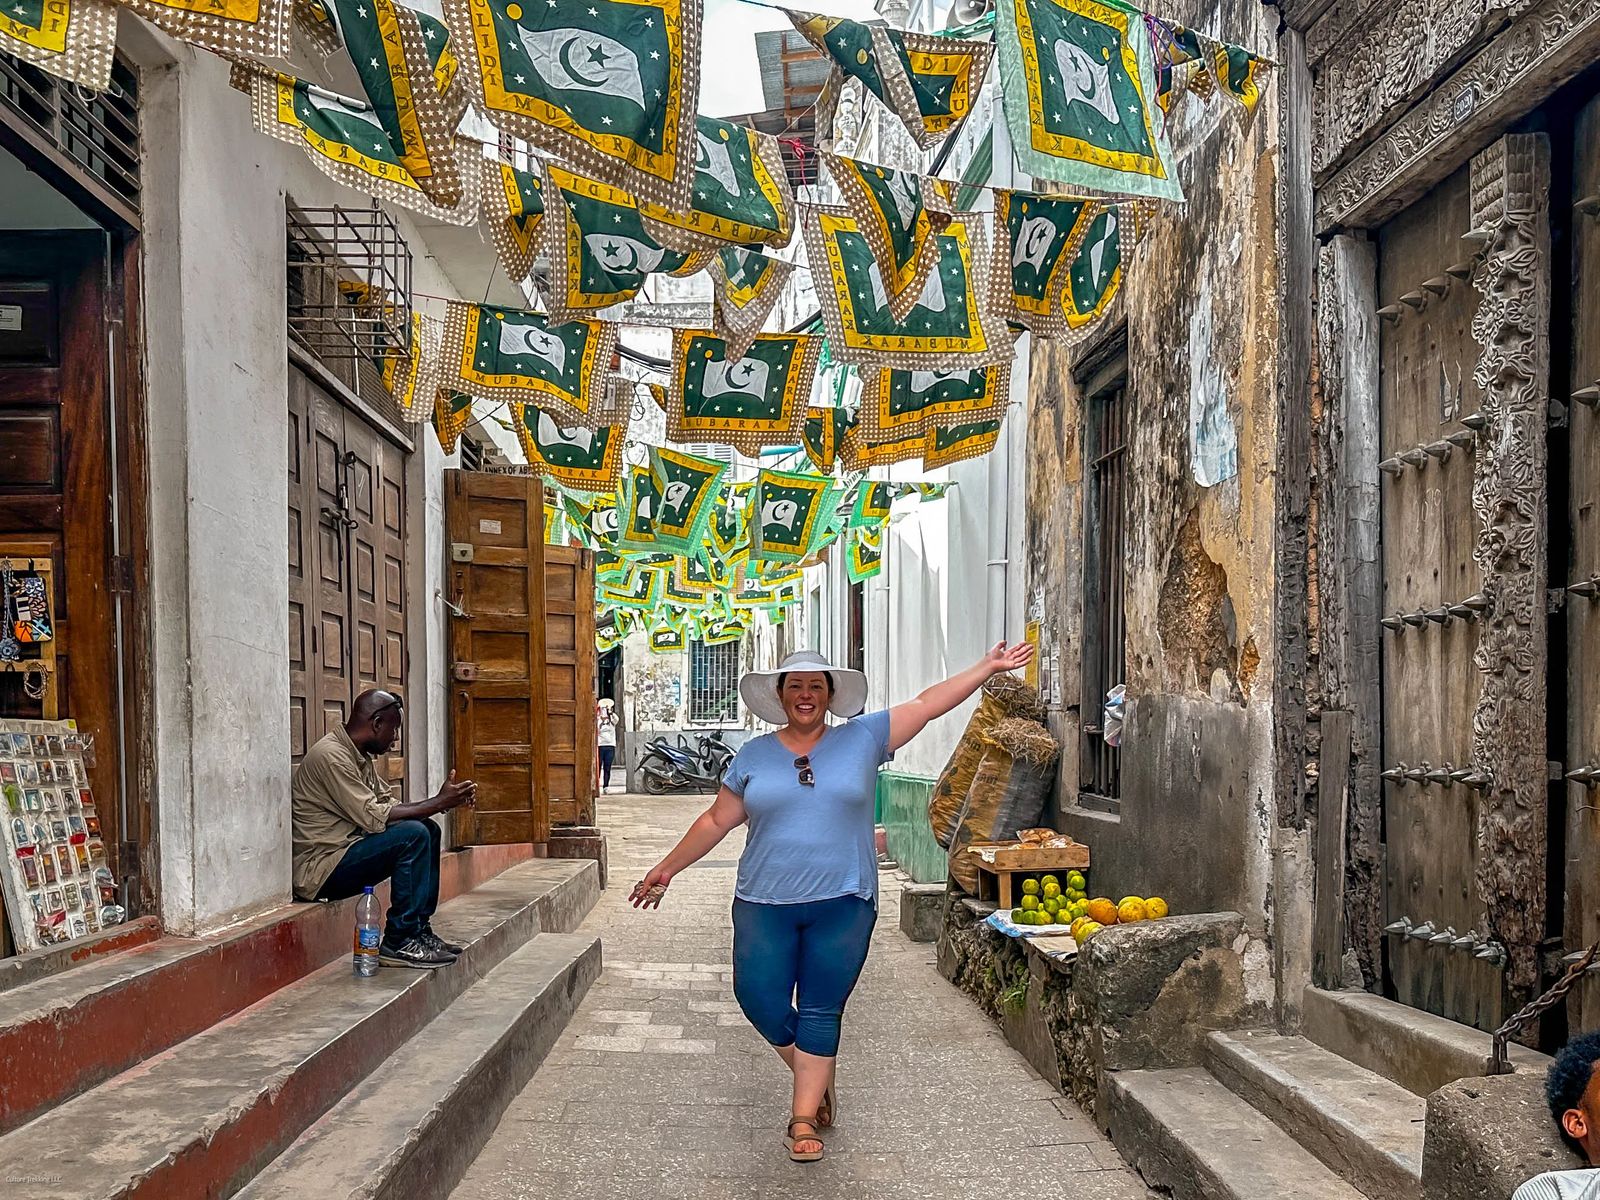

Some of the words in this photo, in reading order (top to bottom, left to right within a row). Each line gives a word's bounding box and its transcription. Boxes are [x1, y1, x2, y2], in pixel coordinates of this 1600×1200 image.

[582, 329, 599, 402] MUBARAK
[782, 342, 805, 418] MUBARAK
[476, 373, 579, 404] MUBARAK
[686, 417, 776, 430] MUBARAK
[485, 465, 507, 475] ANNEX
[507, 465, 516, 475] OF
